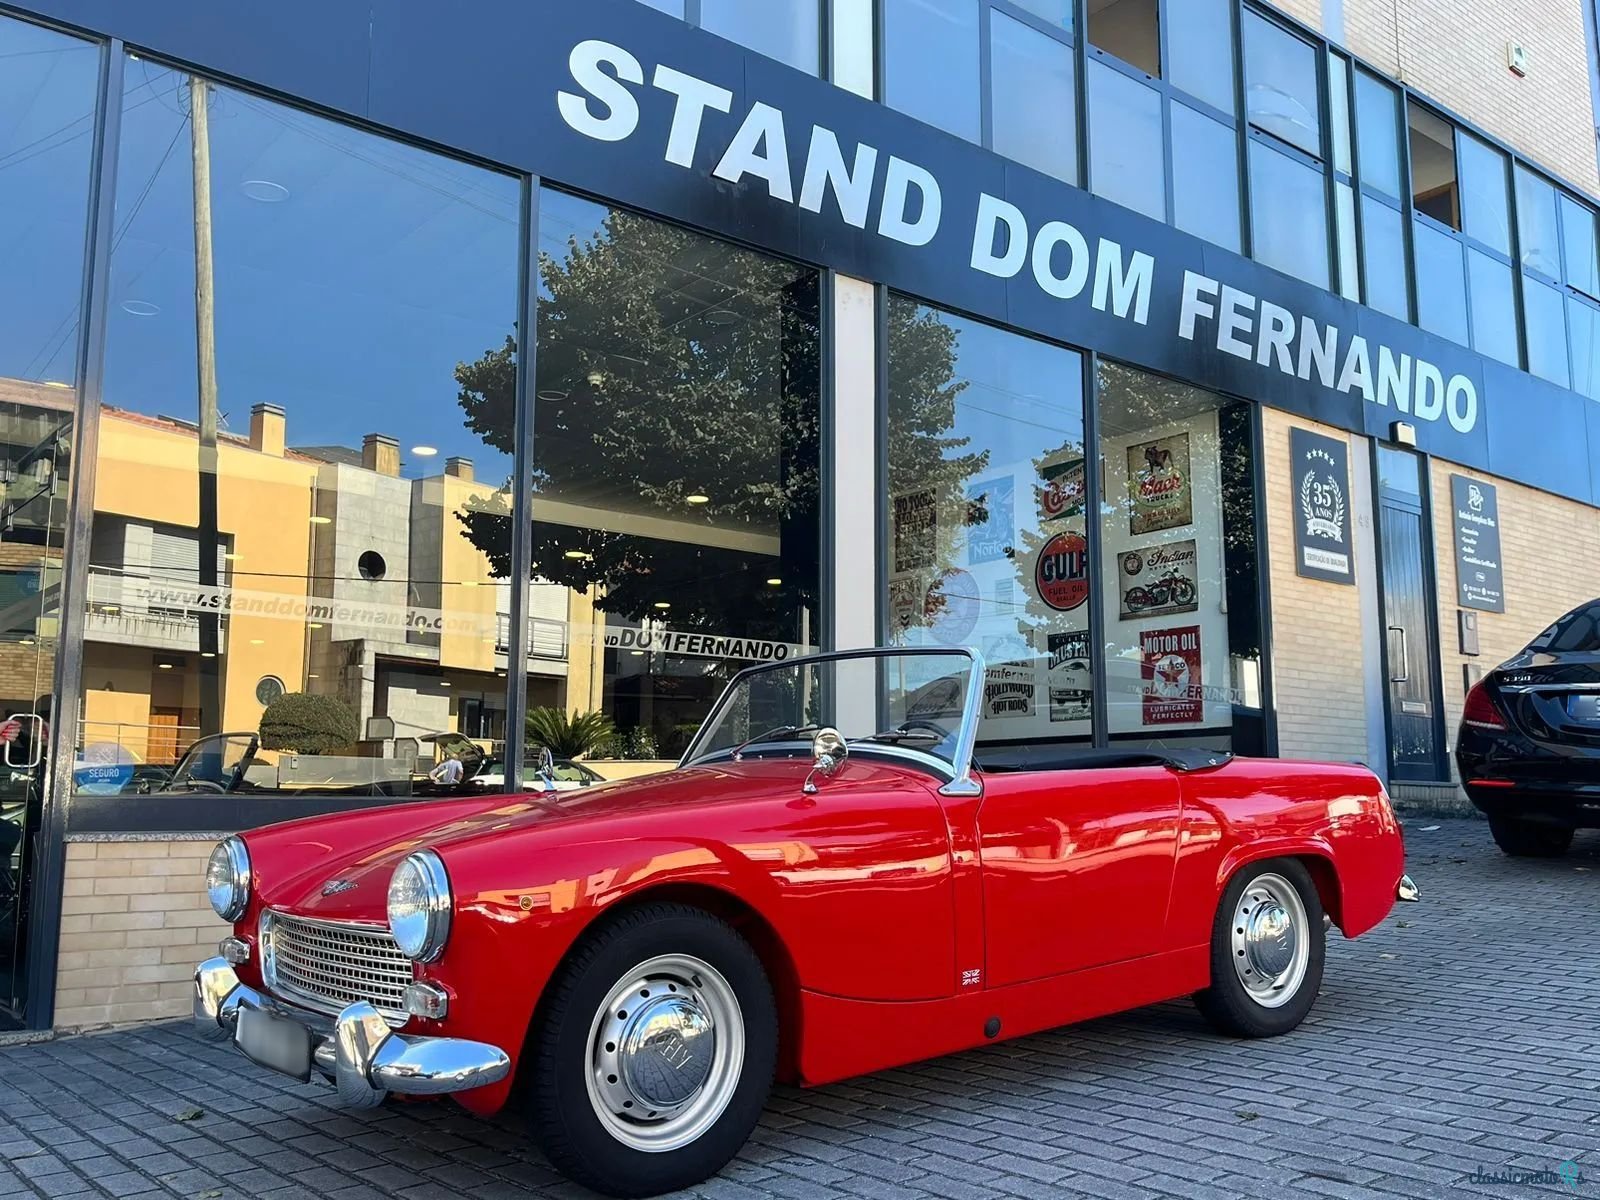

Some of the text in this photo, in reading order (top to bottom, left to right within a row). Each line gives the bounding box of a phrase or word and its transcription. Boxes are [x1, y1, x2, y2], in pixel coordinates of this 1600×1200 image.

[557, 39, 1478, 433] STAND DOM FERNANDO
[1313, 481, 1331, 507] 35
[1315, 507, 1333, 519] ANOS
[1147, 549, 1195, 566] Indian
[1048, 585, 1084, 595] FUEL OIL
[674, 634, 788, 661] FERNANDO
[1144, 633, 1198, 654] MOTOR OIL
[992, 699, 1008, 714] HOT
[1150, 703, 1196, 712] LUBRICATES
[1152, 711, 1193, 720] PERFECTLY
[89, 767, 120, 779] SEGURO
